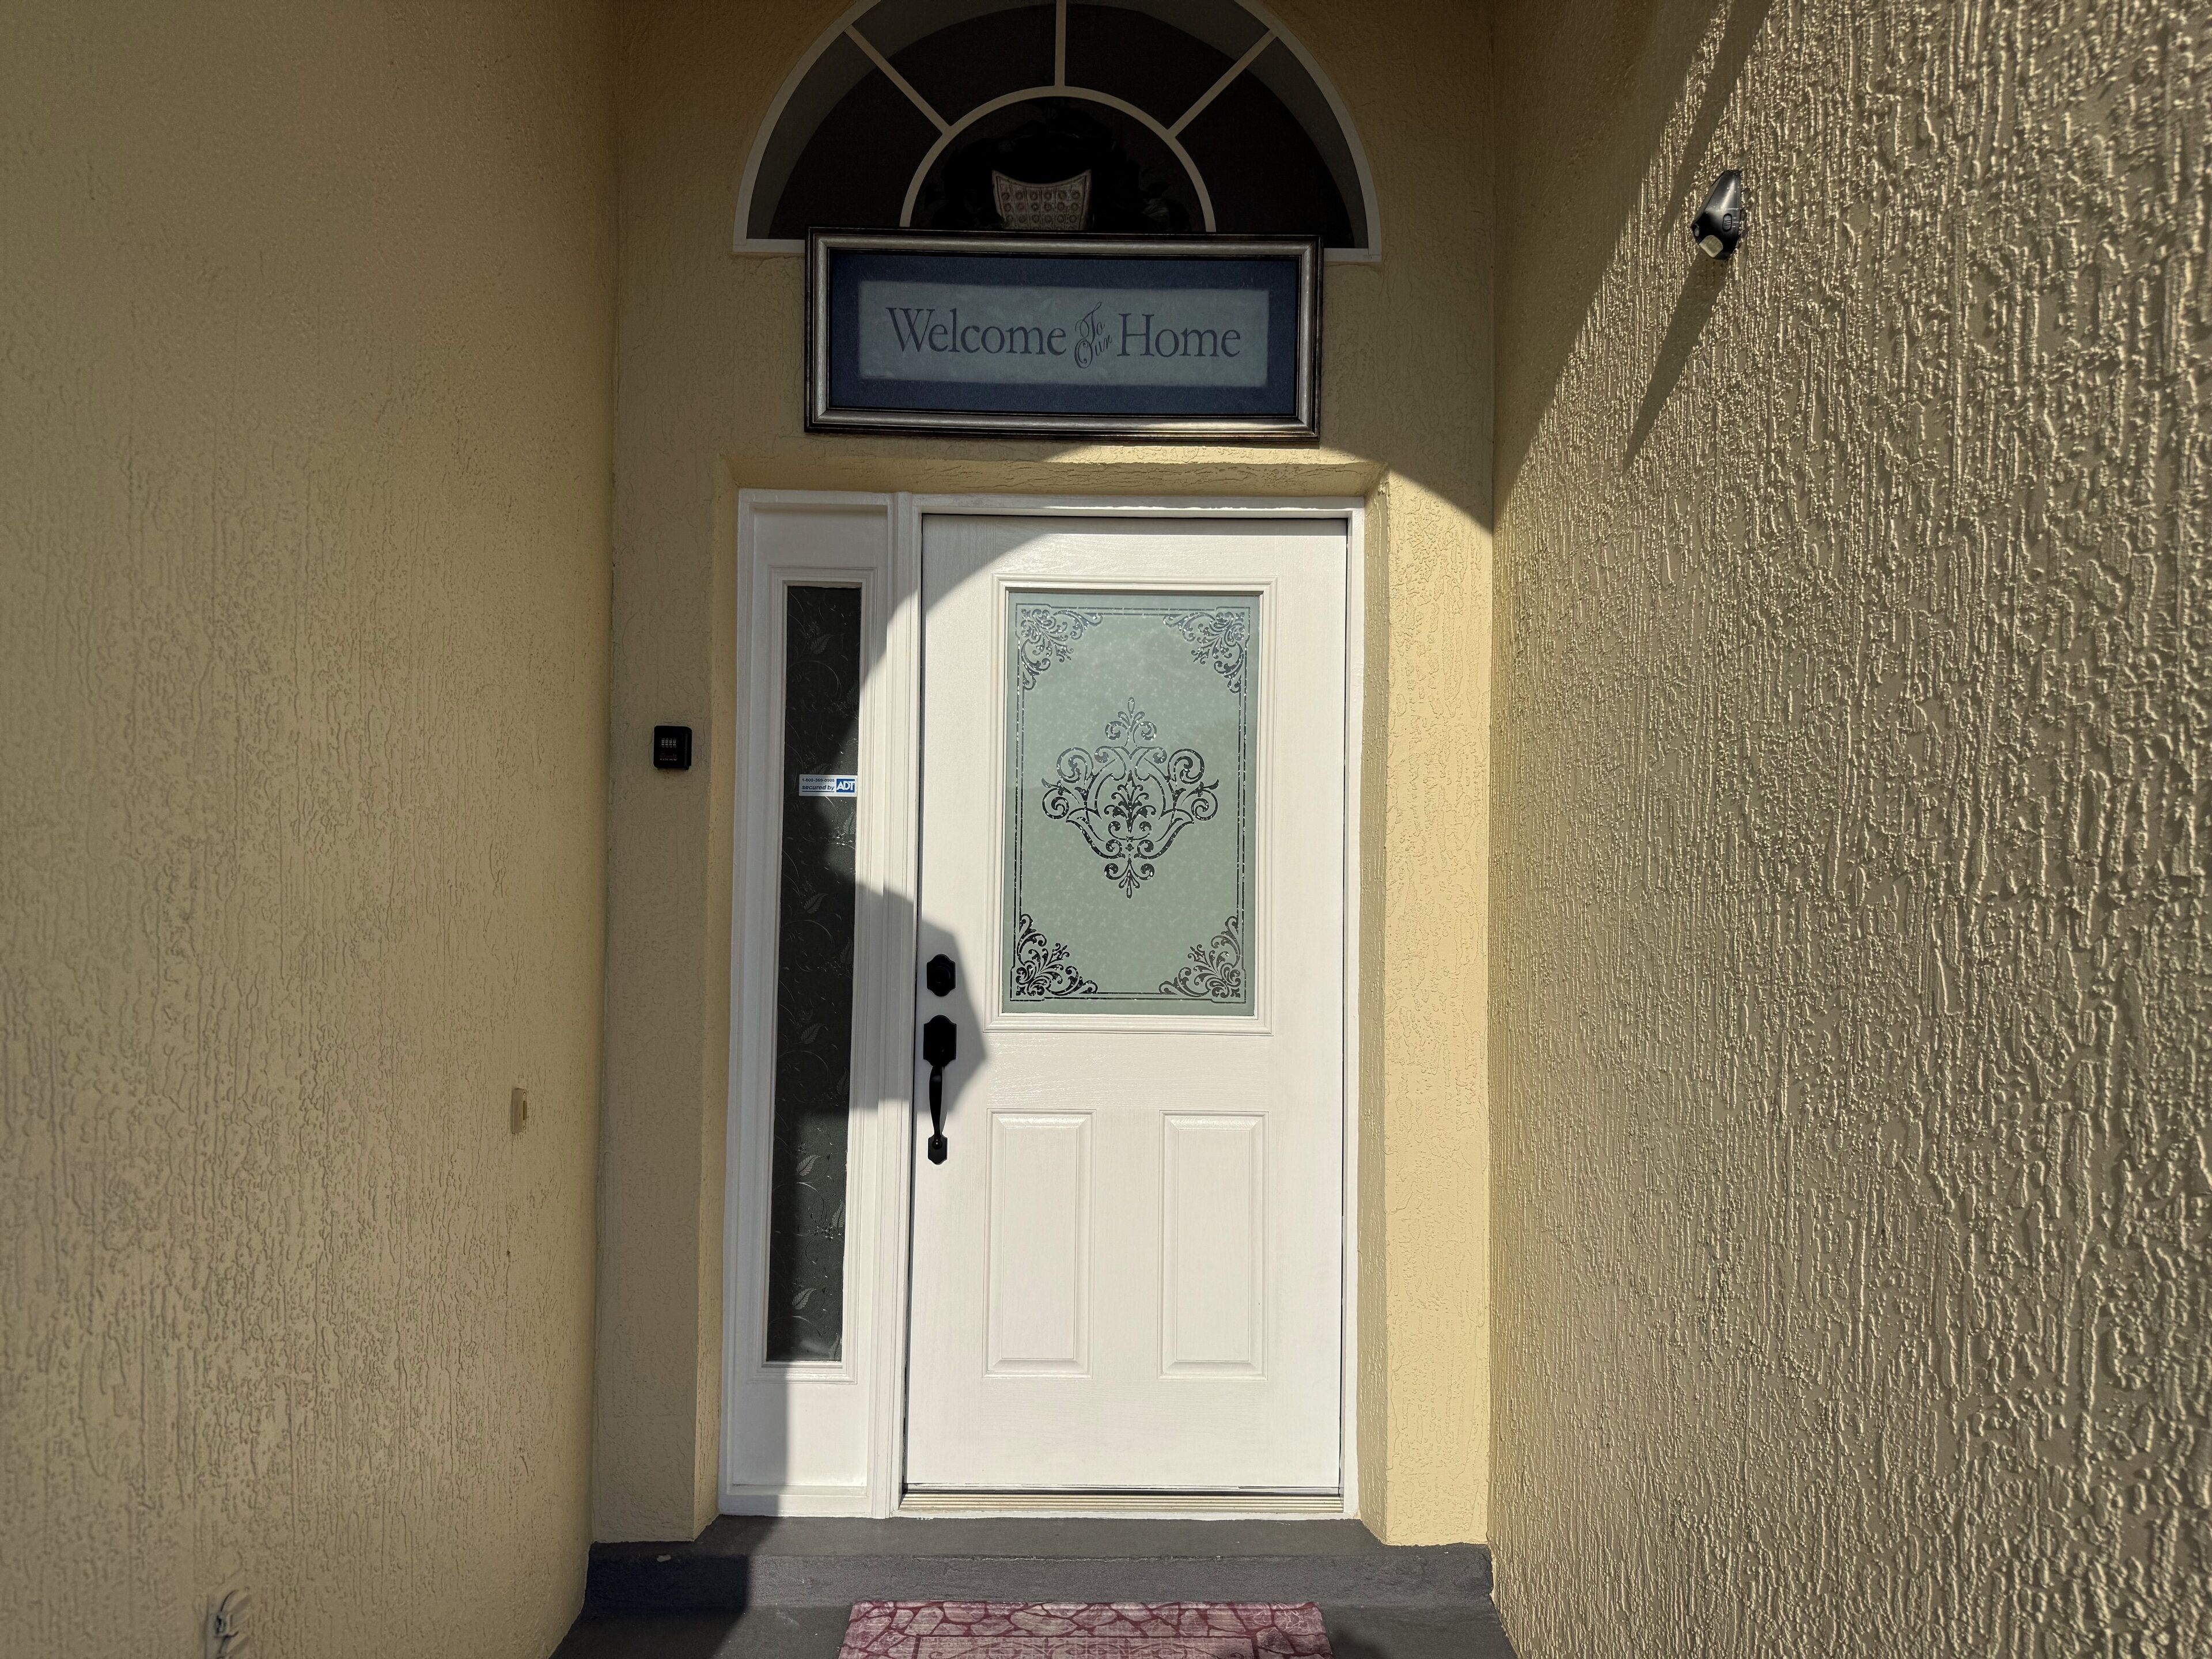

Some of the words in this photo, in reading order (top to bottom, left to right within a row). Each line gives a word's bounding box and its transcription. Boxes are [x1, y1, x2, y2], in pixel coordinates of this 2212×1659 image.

[885, 307, 1067, 355] Welcome
[1075, 301, 1105, 346] To
[1116, 313, 1241, 358] Home
[1074, 335, 1113, 369] Our
[836, 781, 855, 791] ADT
